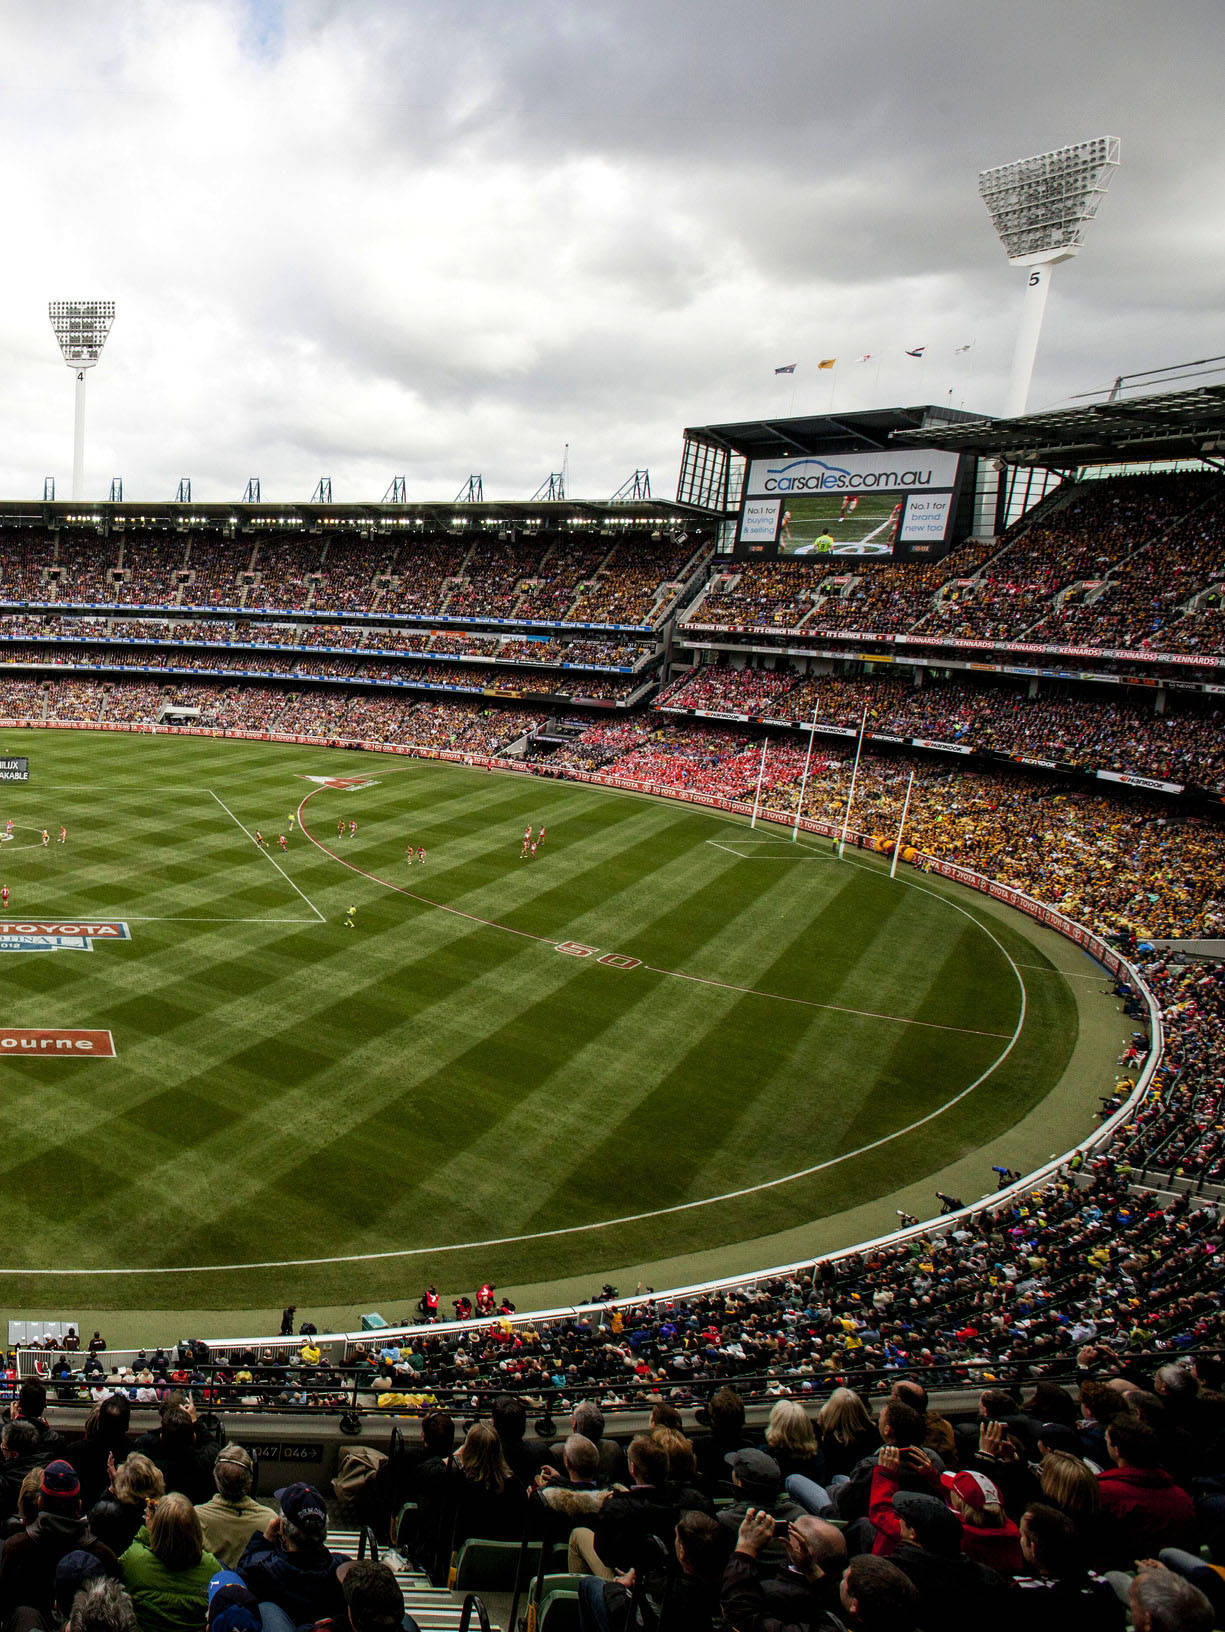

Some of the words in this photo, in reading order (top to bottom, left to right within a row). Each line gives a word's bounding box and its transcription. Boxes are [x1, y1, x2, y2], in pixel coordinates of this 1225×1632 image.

[1028, 272, 1040, 286] 5
[77, 372, 84, 381] 4
[764, 470, 932, 491] carsales.com.au
[765, 506, 776, 514] for
[932, 501, 946, 510] for
[746, 516, 774, 525] buying
[911, 512, 941, 521] brand
[750, 526, 775, 534] selling
[905, 524, 922, 532] new
[923, 523, 944, 532] too
[906, 636, 940, 644] KENNARDS
[956, 640, 992, 648] KENNARDS
[1008, 643, 1044, 651] KENNARDS
[1060, 647, 1098, 656] KENNARDS
[1115, 651, 1154, 660] KENNARDS
[1172, 656, 1215, 665] KENNARDS
[554, 941, 643, 970] 50
